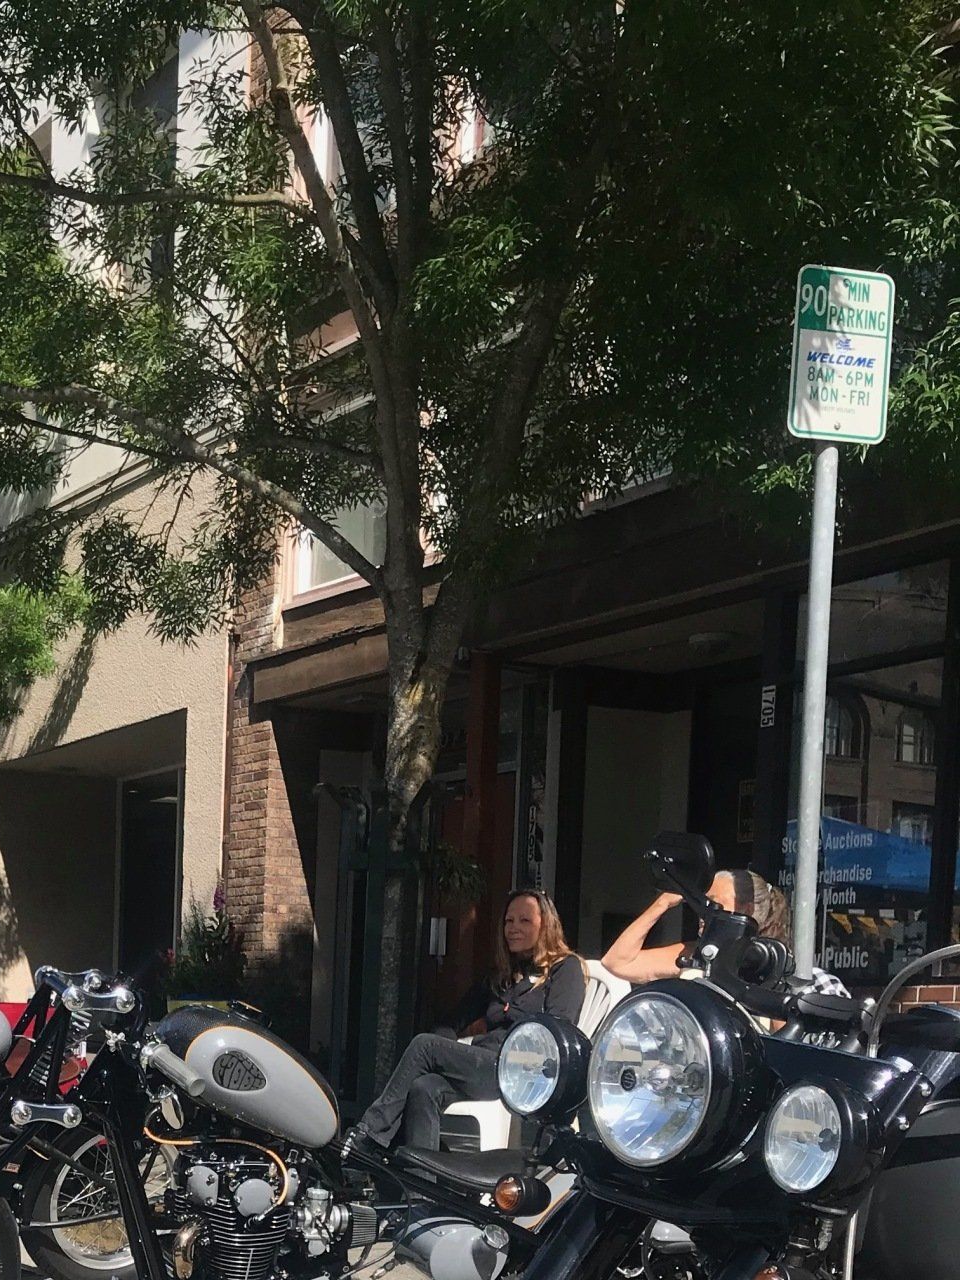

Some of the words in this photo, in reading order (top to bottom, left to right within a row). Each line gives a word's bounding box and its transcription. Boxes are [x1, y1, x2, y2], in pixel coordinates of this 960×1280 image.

[801, 284, 827, 316] 90
[848, 281, 870, 303] MIN
[829, 305, 885, 331] PARKING
[807, 351, 876, 368] WELCOME
[808, 366, 834, 383] 8AM
[846, 371, 873, 387] 6PM
[810, 386, 838, 402] MON
[850, 390, 869, 406] FRI
[762, 689, 775, 726] 1705
[825, 831, 872, 850] Auctions
[819, 864, 872, 884] rchandise
[823, 887, 856, 905] Month
[825, 946, 869, 969] Public
